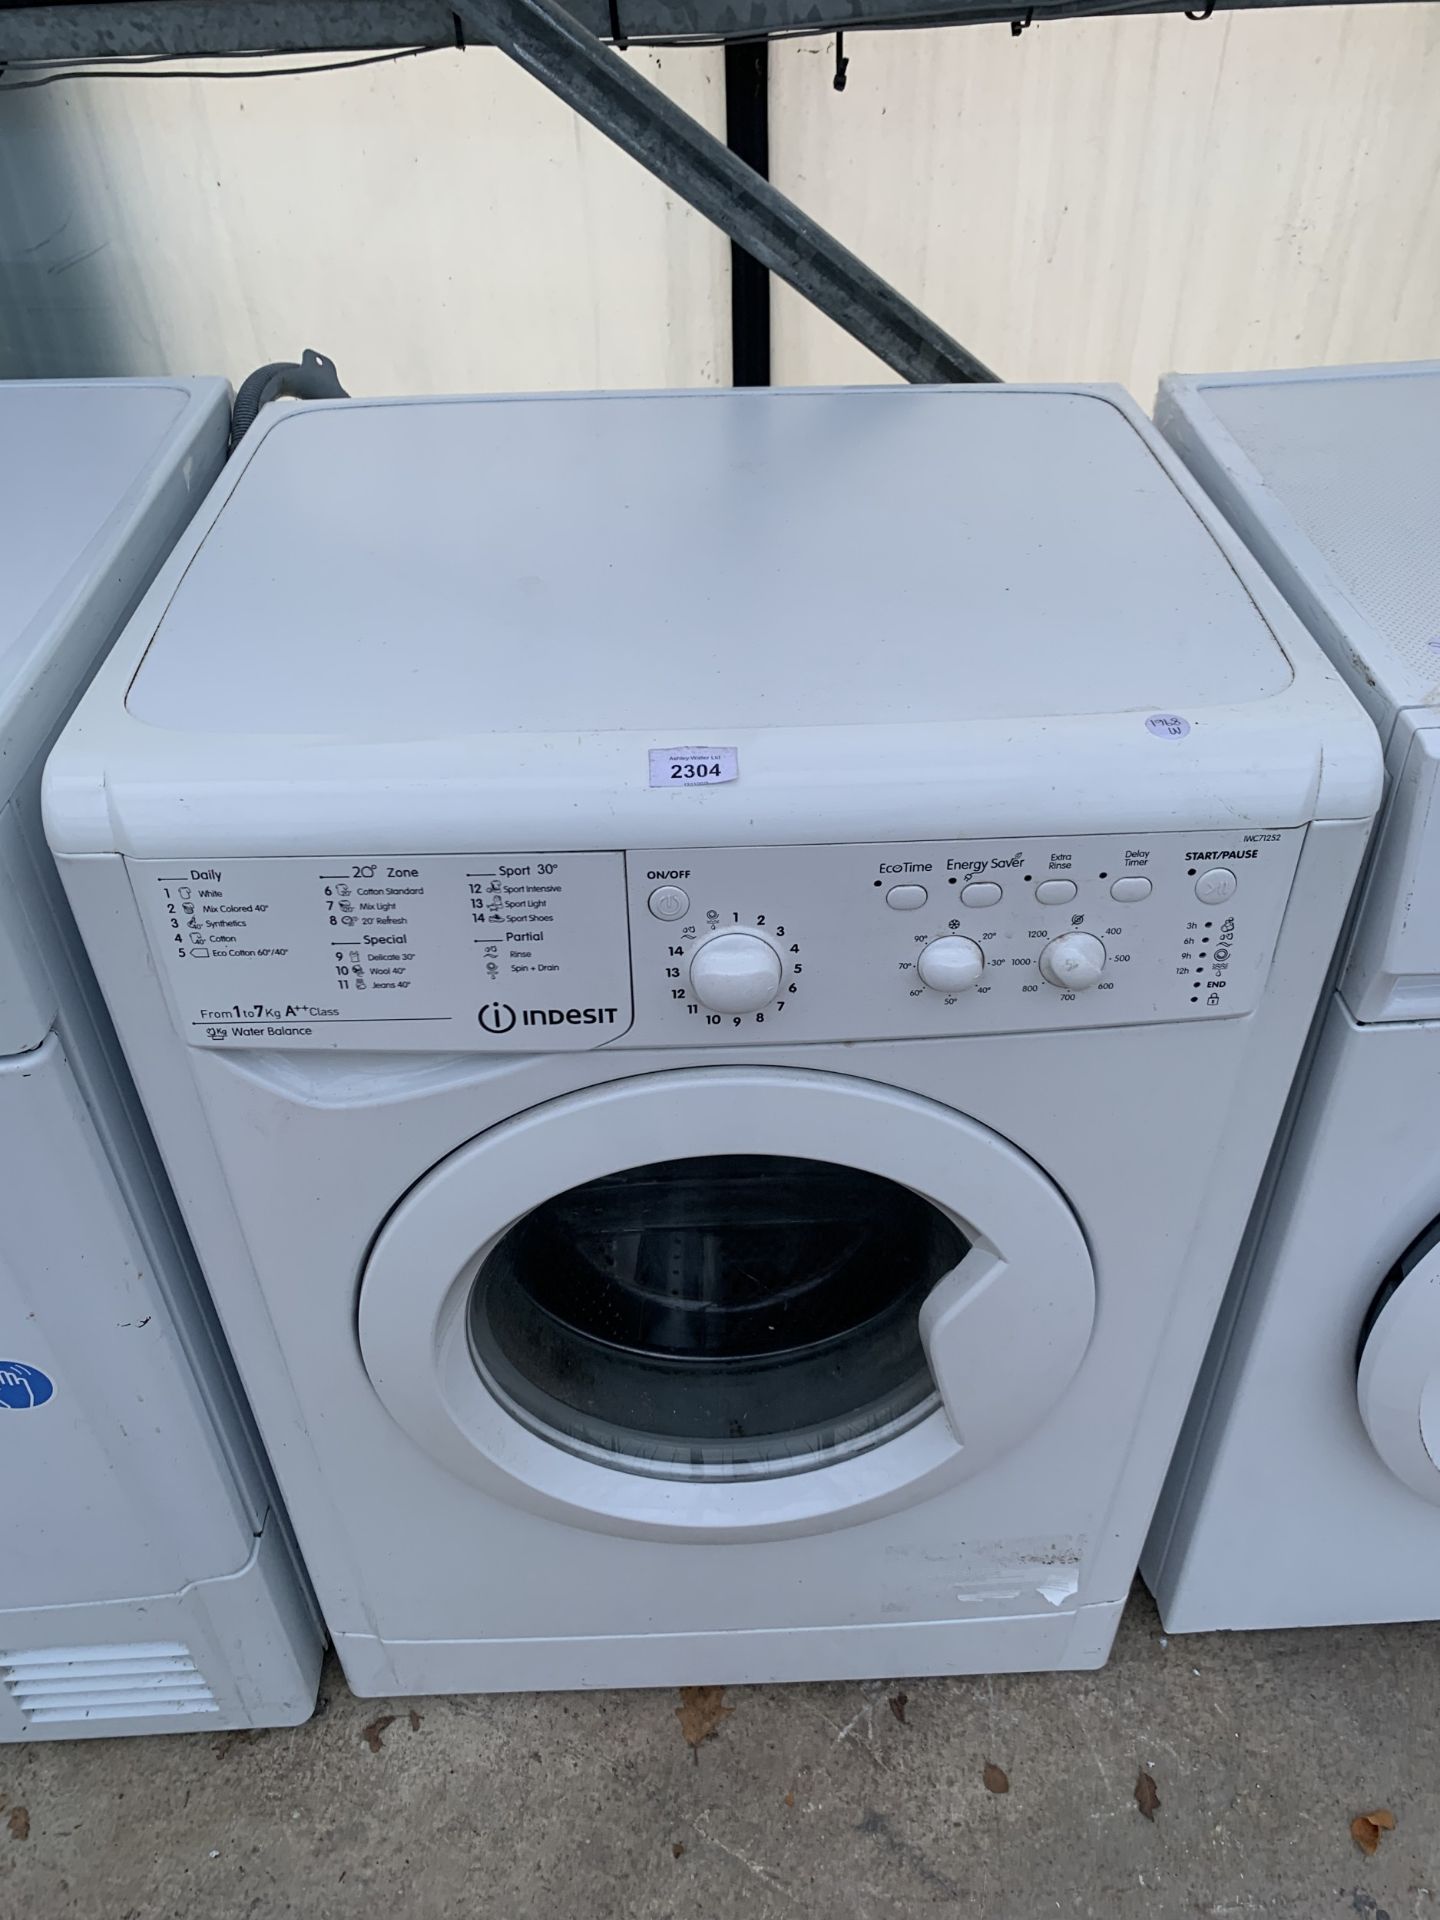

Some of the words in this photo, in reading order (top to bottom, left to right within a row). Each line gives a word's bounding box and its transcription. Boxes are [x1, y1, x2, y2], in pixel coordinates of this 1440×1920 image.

[670, 763, 722, 779] 2304
[1050, 853, 1072, 861] Extra
[1125, 850, 1150, 859] Delay
[1185, 850, 1259, 861] START/PAUSE
[946, 858, 988, 872] Energy
[991, 857, 1024, 869] Saver
[1049, 861, 1072, 870] Rinse
[1125, 858, 1148, 867] Timer
[386, 867, 419, 878] Zone
[499, 864, 531, 878] Sport
[537, 864, 558, 875] 30°
[879, 862, 933, 874] EcoTime
[190, 869, 222, 882] Daily
[647, 870, 691, 879] ON/OFF
[164, 888, 171, 898] 1
[198, 890, 223, 898] White
[324, 885, 332, 896] 6
[357, 888, 384, 896] Cotton
[385, 886, 424, 895] Standard
[469, 884, 481, 894] 12
[503, 885, 525, 895] Sport
[526, 885, 562, 893] Intensive
[167, 903, 176, 914] 2
[203, 905, 218, 913] Mix
[220, 905, 253, 913] Colored
[254, 904, 269, 912] 40°
[326, 900, 334, 910] 7
[360, 902, 375, 910] Mix
[376, 902, 396, 912] Light
[470, 898, 483, 908] 13
[505, 900, 526, 909] Sport
[528, 900, 547, 909] Light
[329, 915, 337, 926] 8
[376, 915, 408, 925] Refresh
[472, 913, 485, 923] 14
[506, 915, 528, 923] Sport
[529, 914, 554, 922] Shoes
[733, 912, 738, 923] 1
[757, 915, 766, 926] 2
[170, 919, 179, 928] 3
[205, 920, 247, 929] Synthetics
[1186, 922, 1197, 930] 3h
[776, 926, 785, 936] 3
[1028, 930, 1048, 938] 1200
[1105, 927, 1122, 935] 400
[174, 934, 182, 943] 4
[209, 935, 237, 943] Cotton
[363, 934, 407, 947] Special
[506, 931, 544, 942] Partial
[178, 948, 186, 958] 5
[229, 949, 256, 957] Cotton
[668, 946, 684, 956] 14
[790, 944, 800, 953] 4
[335, 952, 343, 961] 9
[368, 953, 400, 961] Delicate
[510, 950, 532, 958] Rinse
[1114, 954, 1130, 962] 500
[1181, 952, 1192, 960] 9h
[1011, 958, 1031, 966] 1000
[336, 966, 349, 976] 10
[511, 964, 528, 973] Spin
[538, 964, 560, 972] Drain
[666, 968, 680, 978] 13
[794, 964, 802, 974] 5
[1176, 967, 1190, 975] 12h
[338, 980, 349, 989] 11
[788, 983, 797, 993] 6
[1098, 982, 1114, 990] 600
[672, 989, 686, 999] 12
[1060, 993, 1076, 1001] 700
[200, 1009, 232, 1019] From
[233, 1005, 241, 1018] 1
[243, 1009, 254, 1018] to
[254, 1005, 264, 1018] 7
[265, 1008, 281, 1019] Kg
[309, 1007, 340, 1016] Class
[687, 1004, 698, 1014] 11
[777, 1002, 785, 1012] 7
[706, 1015, 721, 1025] 10
[733, 1016, 741, 1027] 9
[756, 1013, 764, 1023] 8
[231, 1027, 264, 1037] Water
[267, 1026, 312, 1036] Balance
